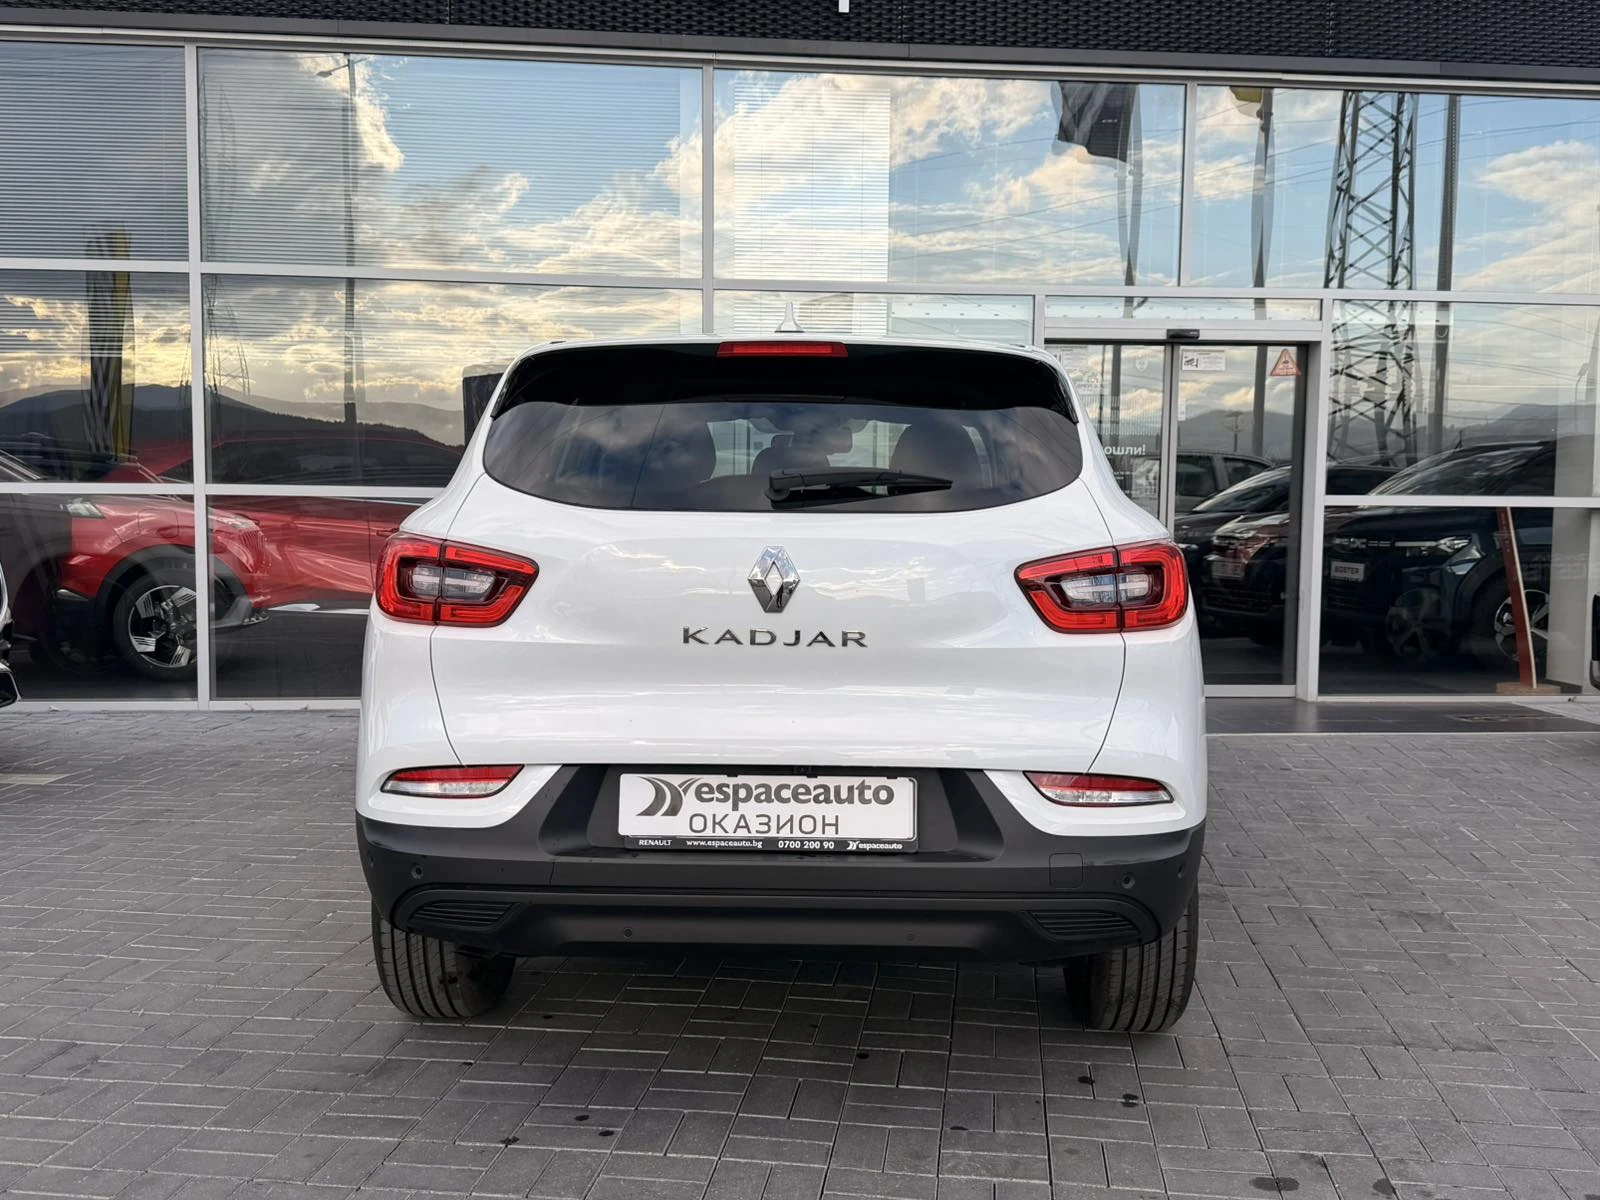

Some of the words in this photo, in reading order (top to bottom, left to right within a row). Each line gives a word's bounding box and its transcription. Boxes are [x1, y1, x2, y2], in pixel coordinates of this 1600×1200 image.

[1103, 444, 1146, 456] ошли!
[682, 626, 868, 648] KADJAR
[694, 779, 895, 811] espaceauto
[689, 813, 839, 835] ОКАЗИОН
[686, 840, 763, 849] www.espaceauto.bg
[778, 840, 801, 849] 0700
[803, 840, 821, 849] 200
[823, 841, 835, 850] 90
[858, 842, 903, 851] espaceauto
